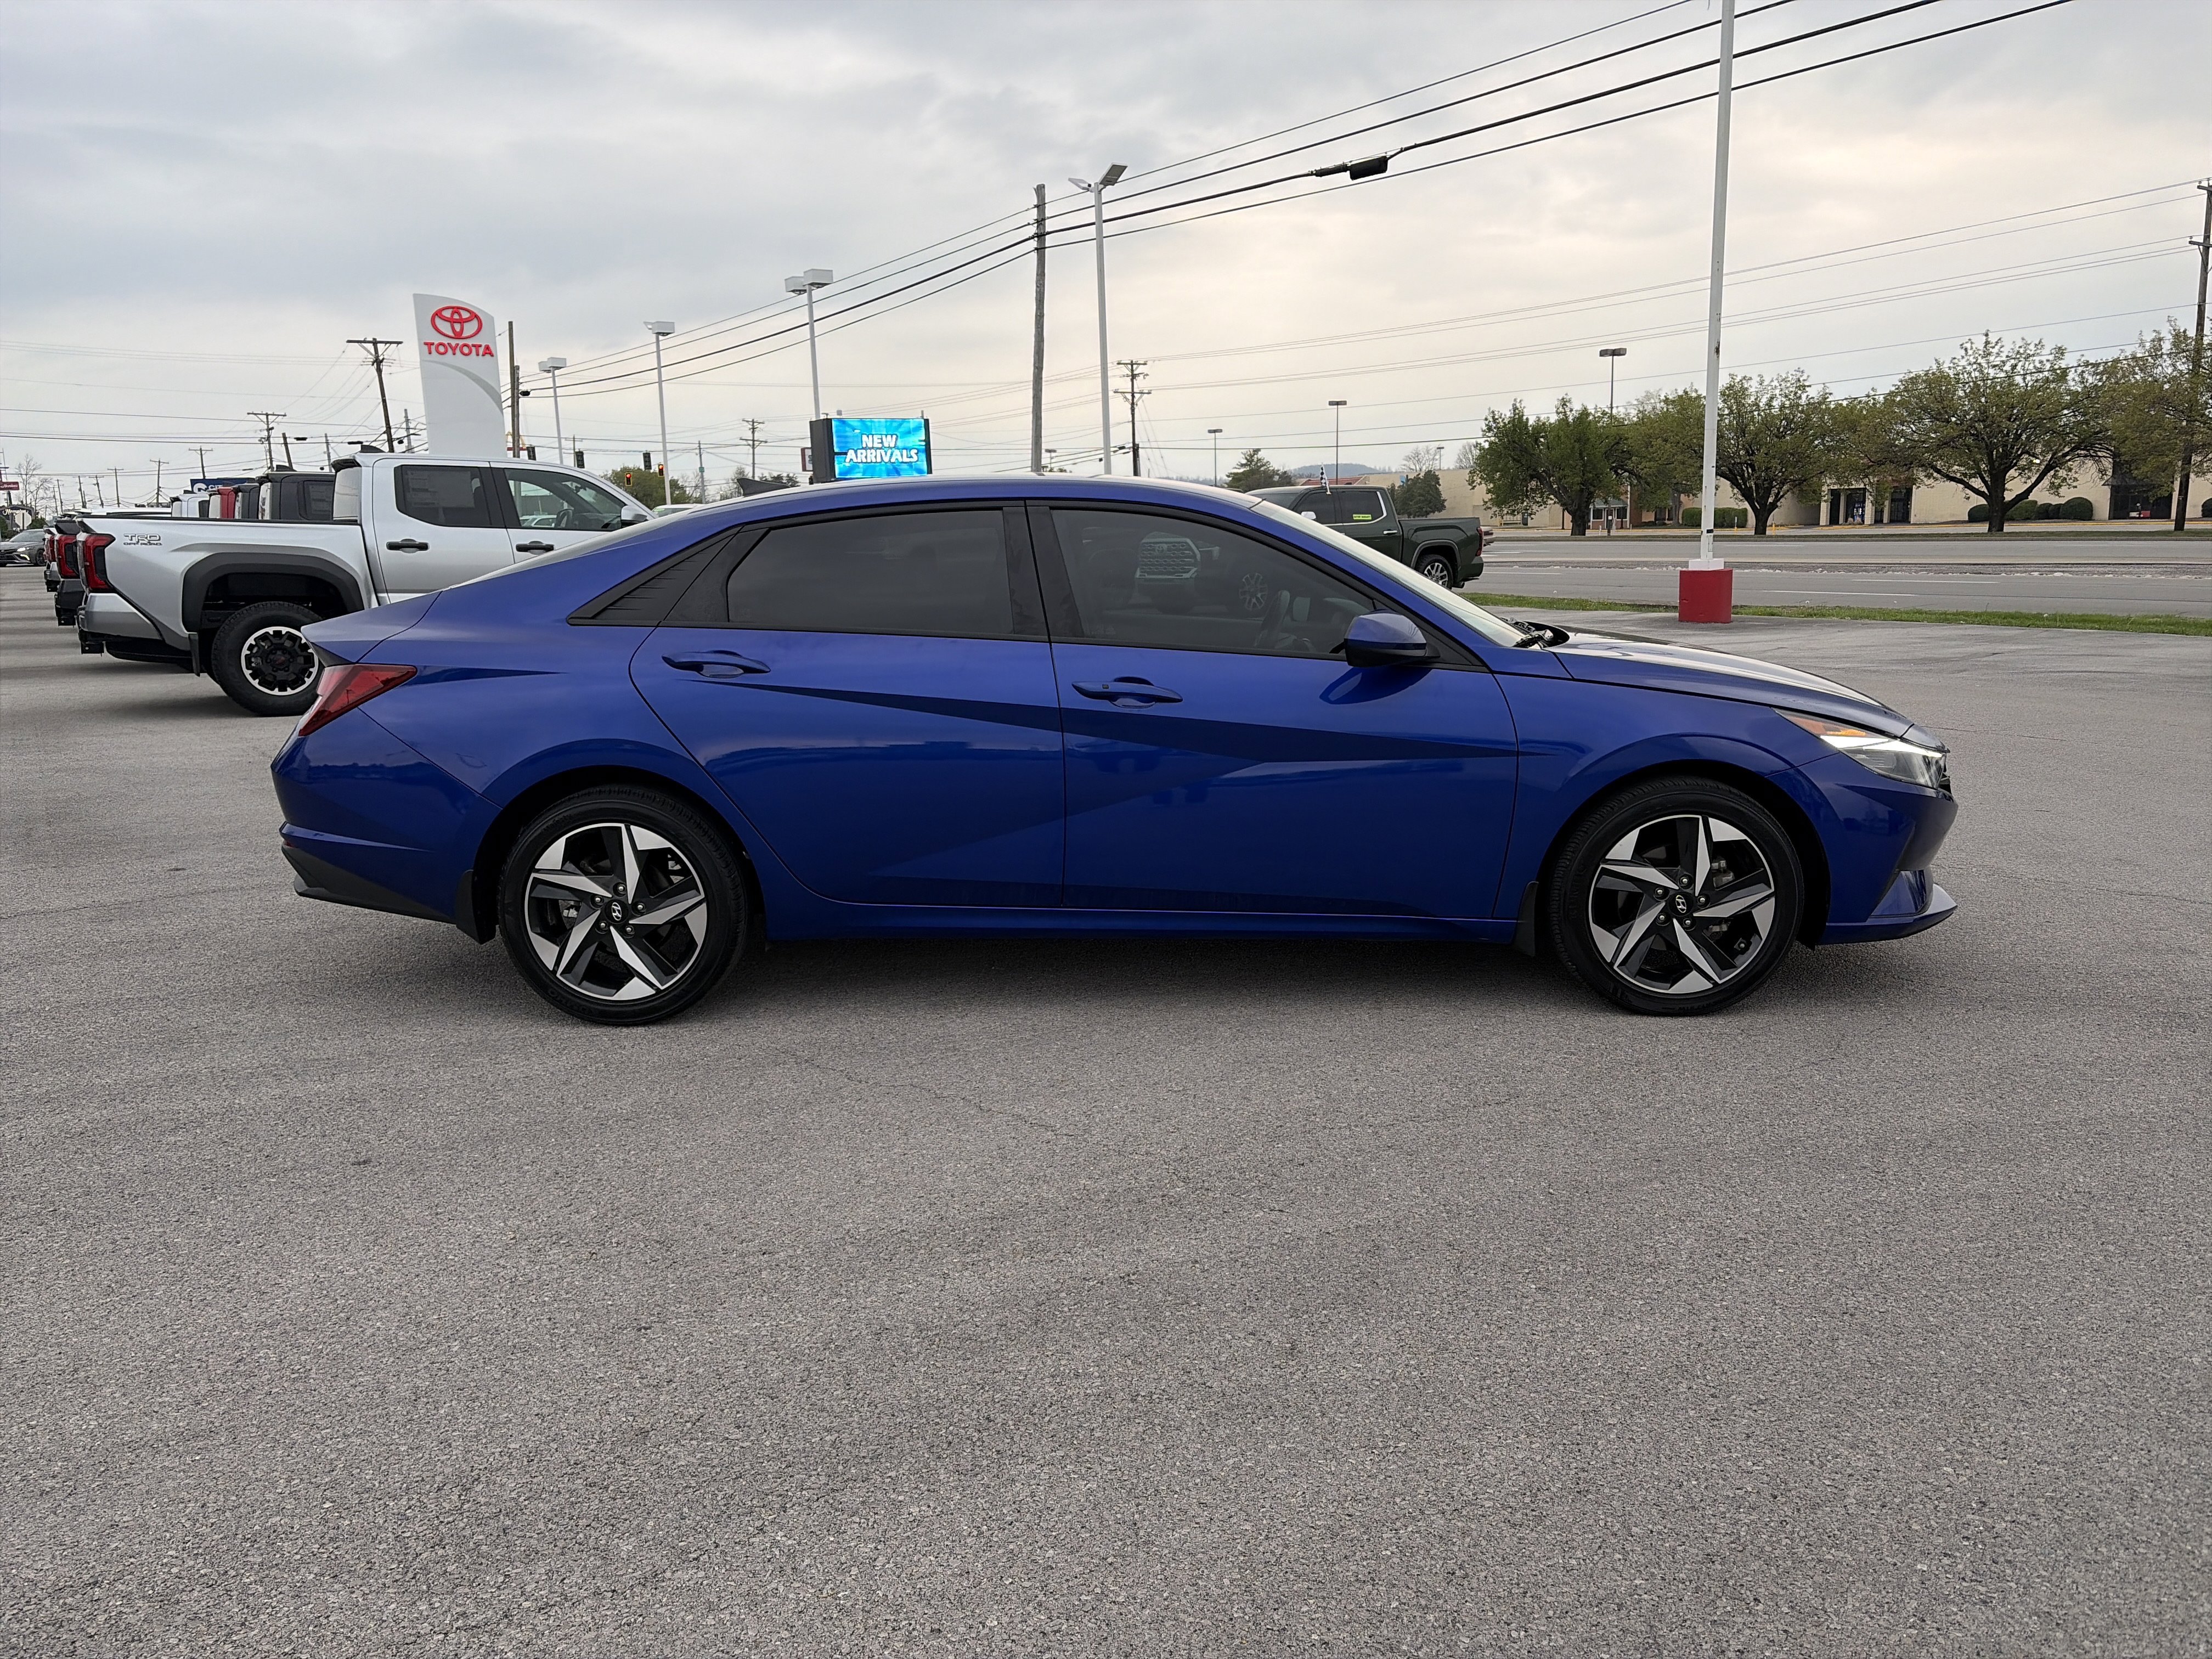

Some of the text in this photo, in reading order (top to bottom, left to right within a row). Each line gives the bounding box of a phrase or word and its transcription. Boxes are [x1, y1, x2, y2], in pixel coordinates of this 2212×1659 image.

[424, 342, 494, 357] TOYOTA
[861, 435, 897, 448] NEW
[845, 448, 918, 462] ARRIVALS
[123, 534, 161, 543] TRD
